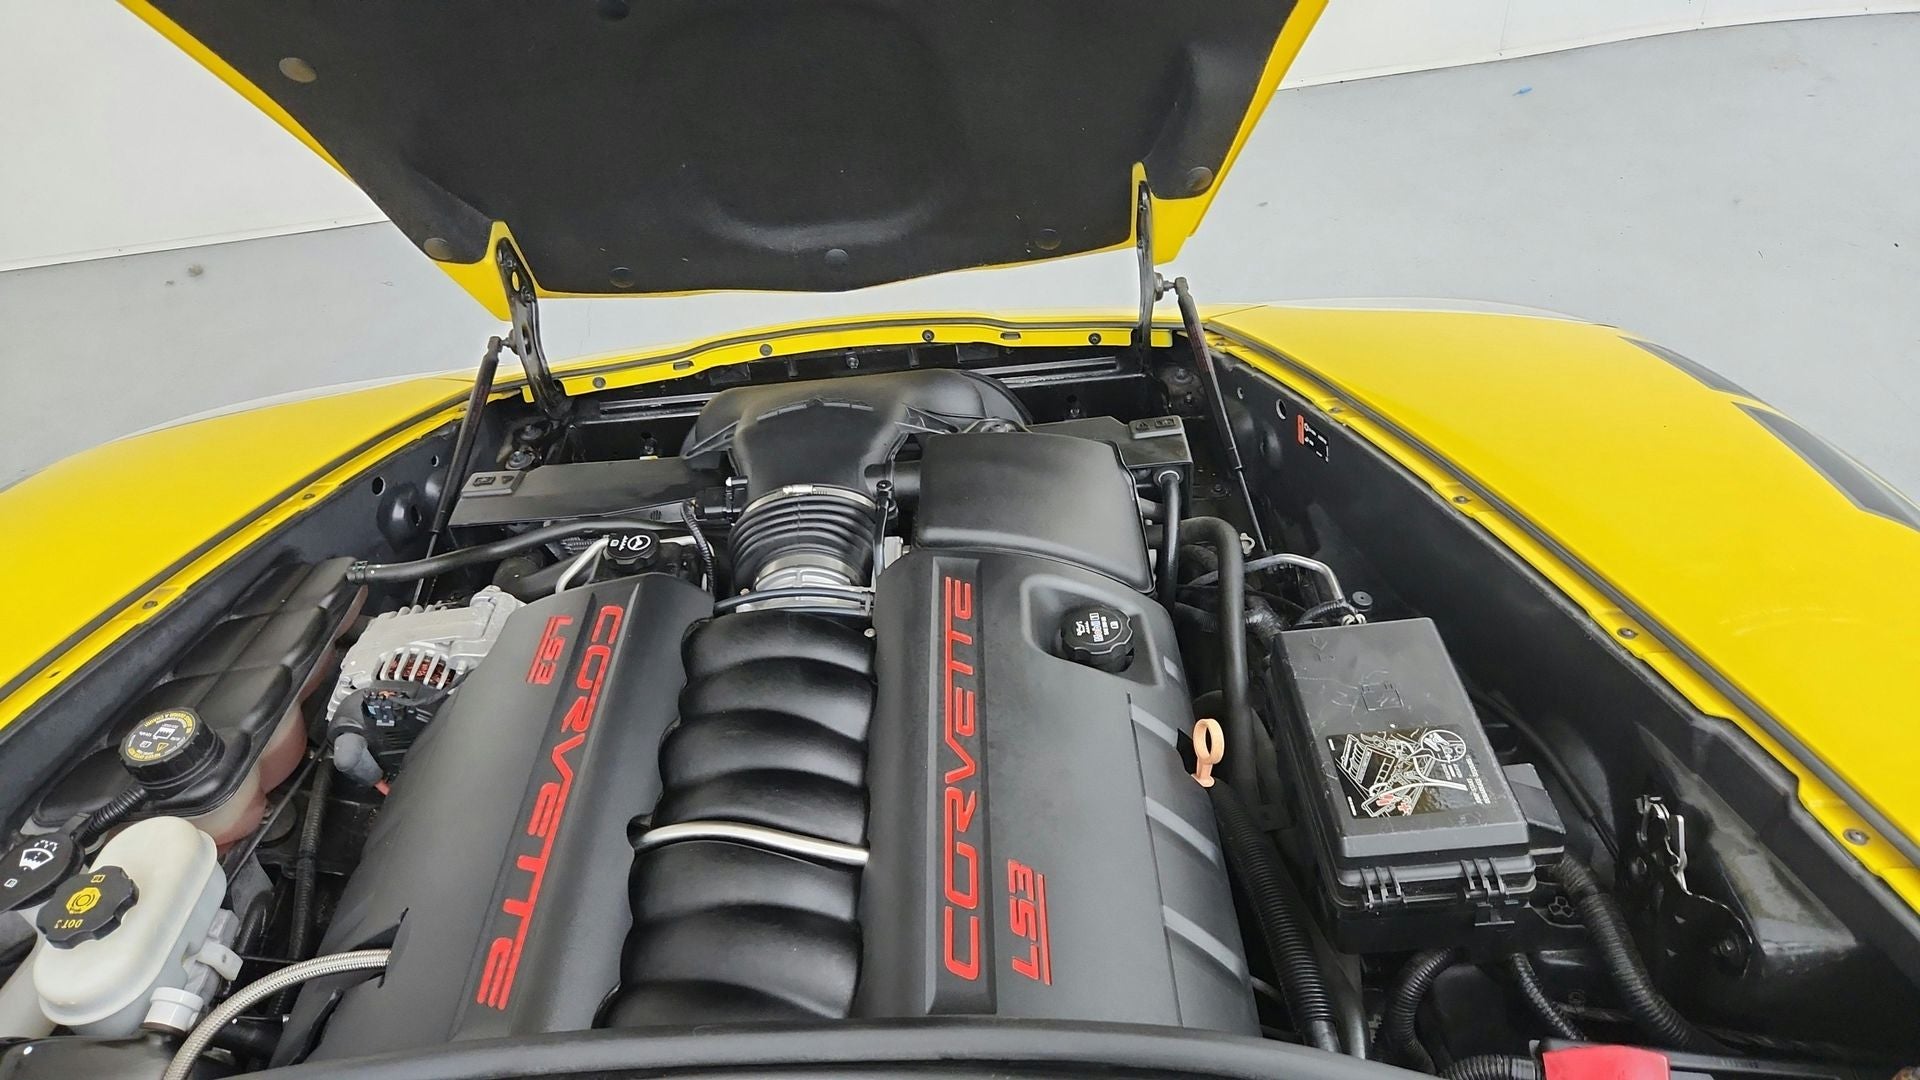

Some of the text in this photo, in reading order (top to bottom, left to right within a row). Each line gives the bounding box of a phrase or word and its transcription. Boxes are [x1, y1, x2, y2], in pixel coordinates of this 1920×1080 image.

[532, 615, 573, 685] LS3
[476, 604, 625, 1011] CORVETTE
[944, 576, 980, 981] CORVETTE
[61, 919, 84, 929] DOT
[1008, 858, 1041, 981] LS3
